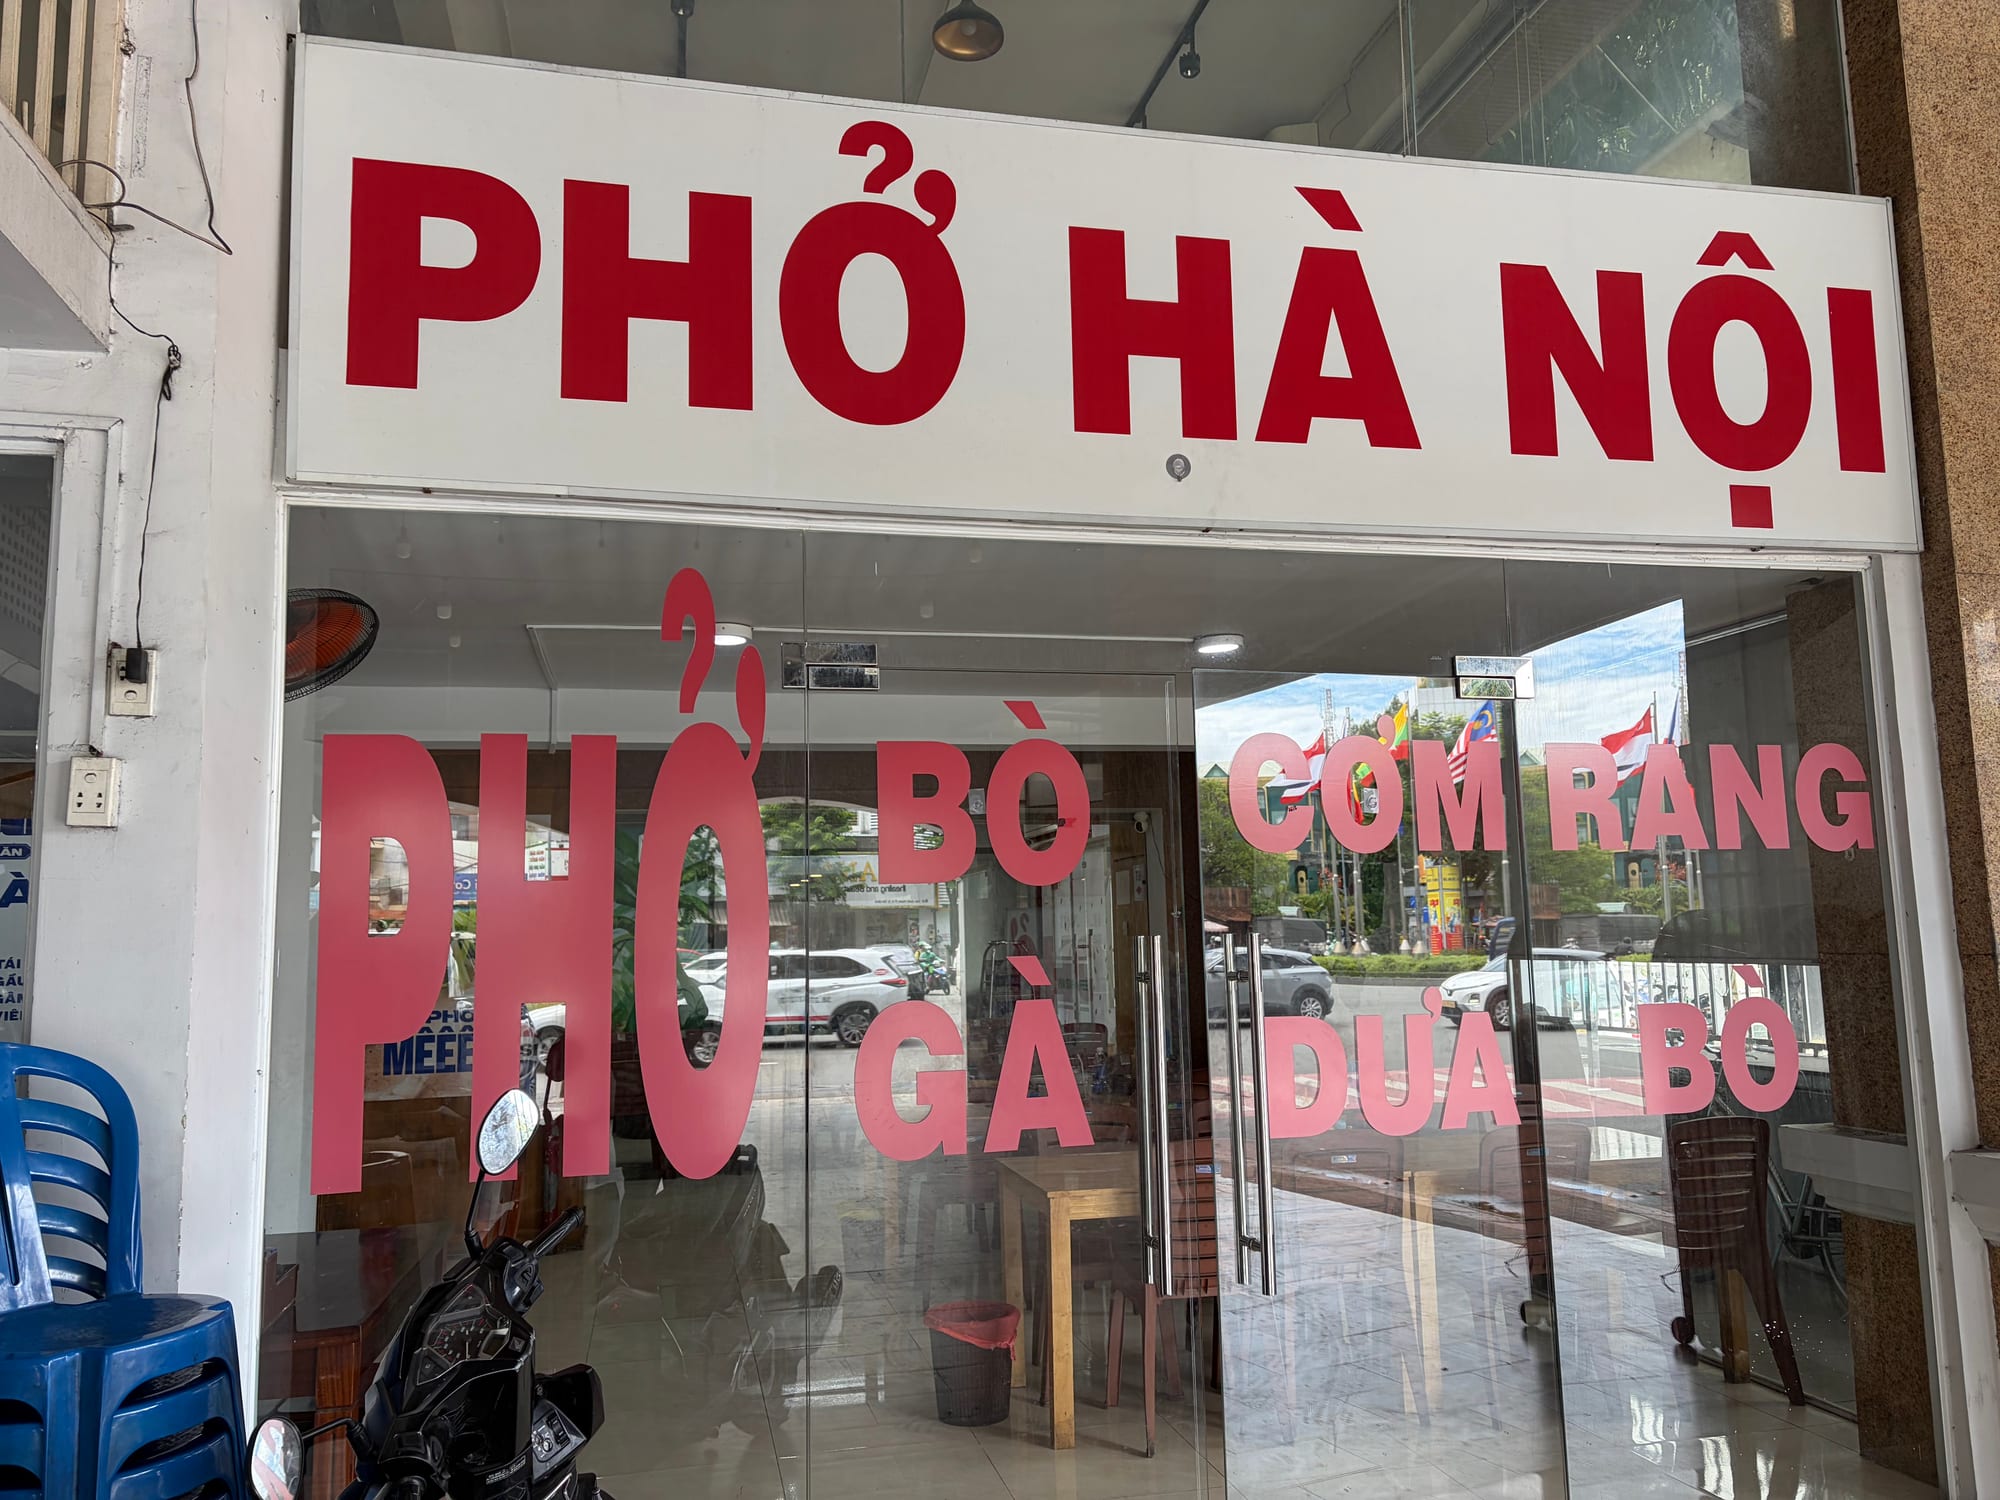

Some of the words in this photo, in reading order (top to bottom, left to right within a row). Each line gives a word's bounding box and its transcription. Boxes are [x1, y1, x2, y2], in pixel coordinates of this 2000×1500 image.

[346, 121, 967, 426] PHỞ
[1068, 187, 1422, 450] HÀ
[1500, 231, 1887, 529] NỘI
[877, 701, 1091, 886] BÒ
[1230, 714, 1507, 853] CƠM
[1545, 742, 1875, 852] RANG
[311, 568, 770, 1195] PHỞ
[855, 956, 1095, 1161] GÀ
[1264, 986, 1521, 1138] DƯA
[1638, 965, 1800, 1114] BÒ
